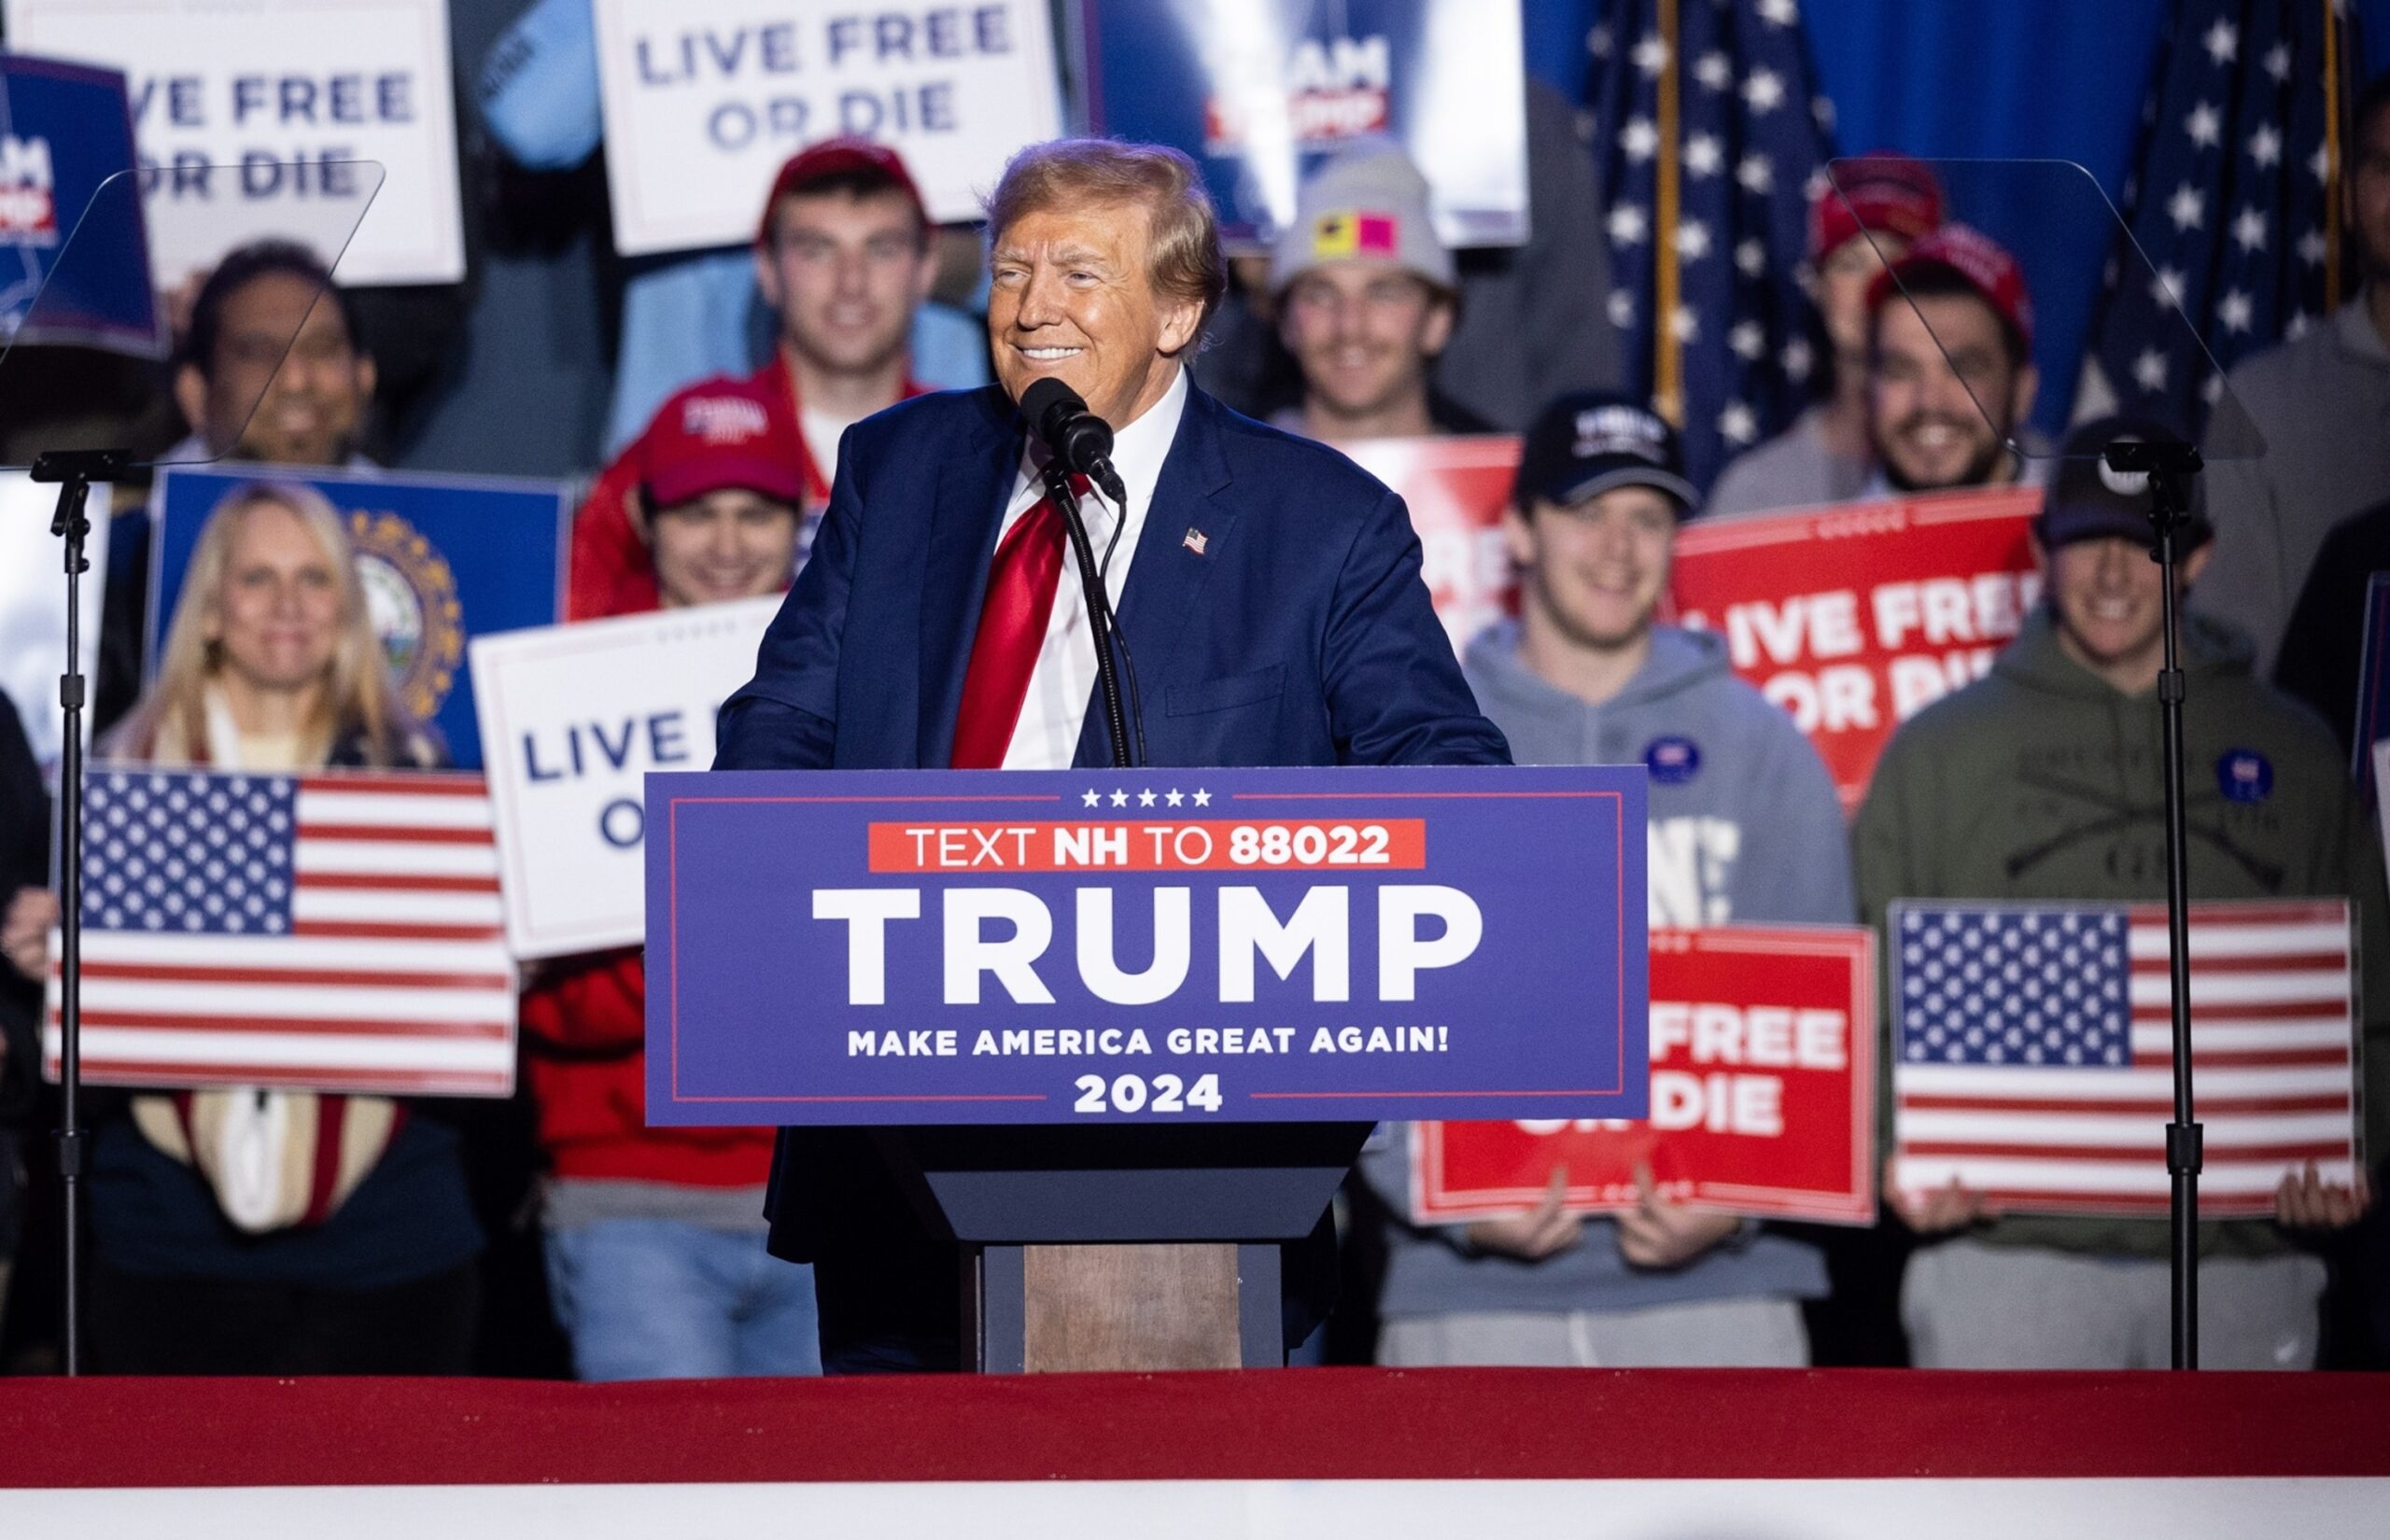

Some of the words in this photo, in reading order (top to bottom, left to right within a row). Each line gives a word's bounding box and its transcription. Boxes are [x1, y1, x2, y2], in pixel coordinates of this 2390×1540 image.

[634, 21, 799, 86] LIVE
[826, 4, 1012, 66] FREE
[233, 72, 414, 128] FREE
[707, 94, 810, 150] OR
[837, 81, 955, 140] DIE
[241, 147, 357, 200] DIE
[521, 710, 691, 782] LIVE
[598, 798, 644, 848] O
[907, 828, 1036, 866] TEXT
[1054, 827, 1128, 865] NH
[1144, 826, 1214, 865] TO
[1230, 825, 1390, 864] 88022
[812, 885, 1483, 1005] TRUMP
[848, 1030, 958, 1057] MAKE
[972, 1029, 1152, 1056] AMERICA
[1167, 1028, 1296, 1055] GREAT
[1309, 1026, 1449, 1053] AGAIN!
[1650, 1001, 1848, 1071] FREE
[1075, 1073, 1224, 1113] 2024
[1650, 1071, 1784, 1137] DIE
